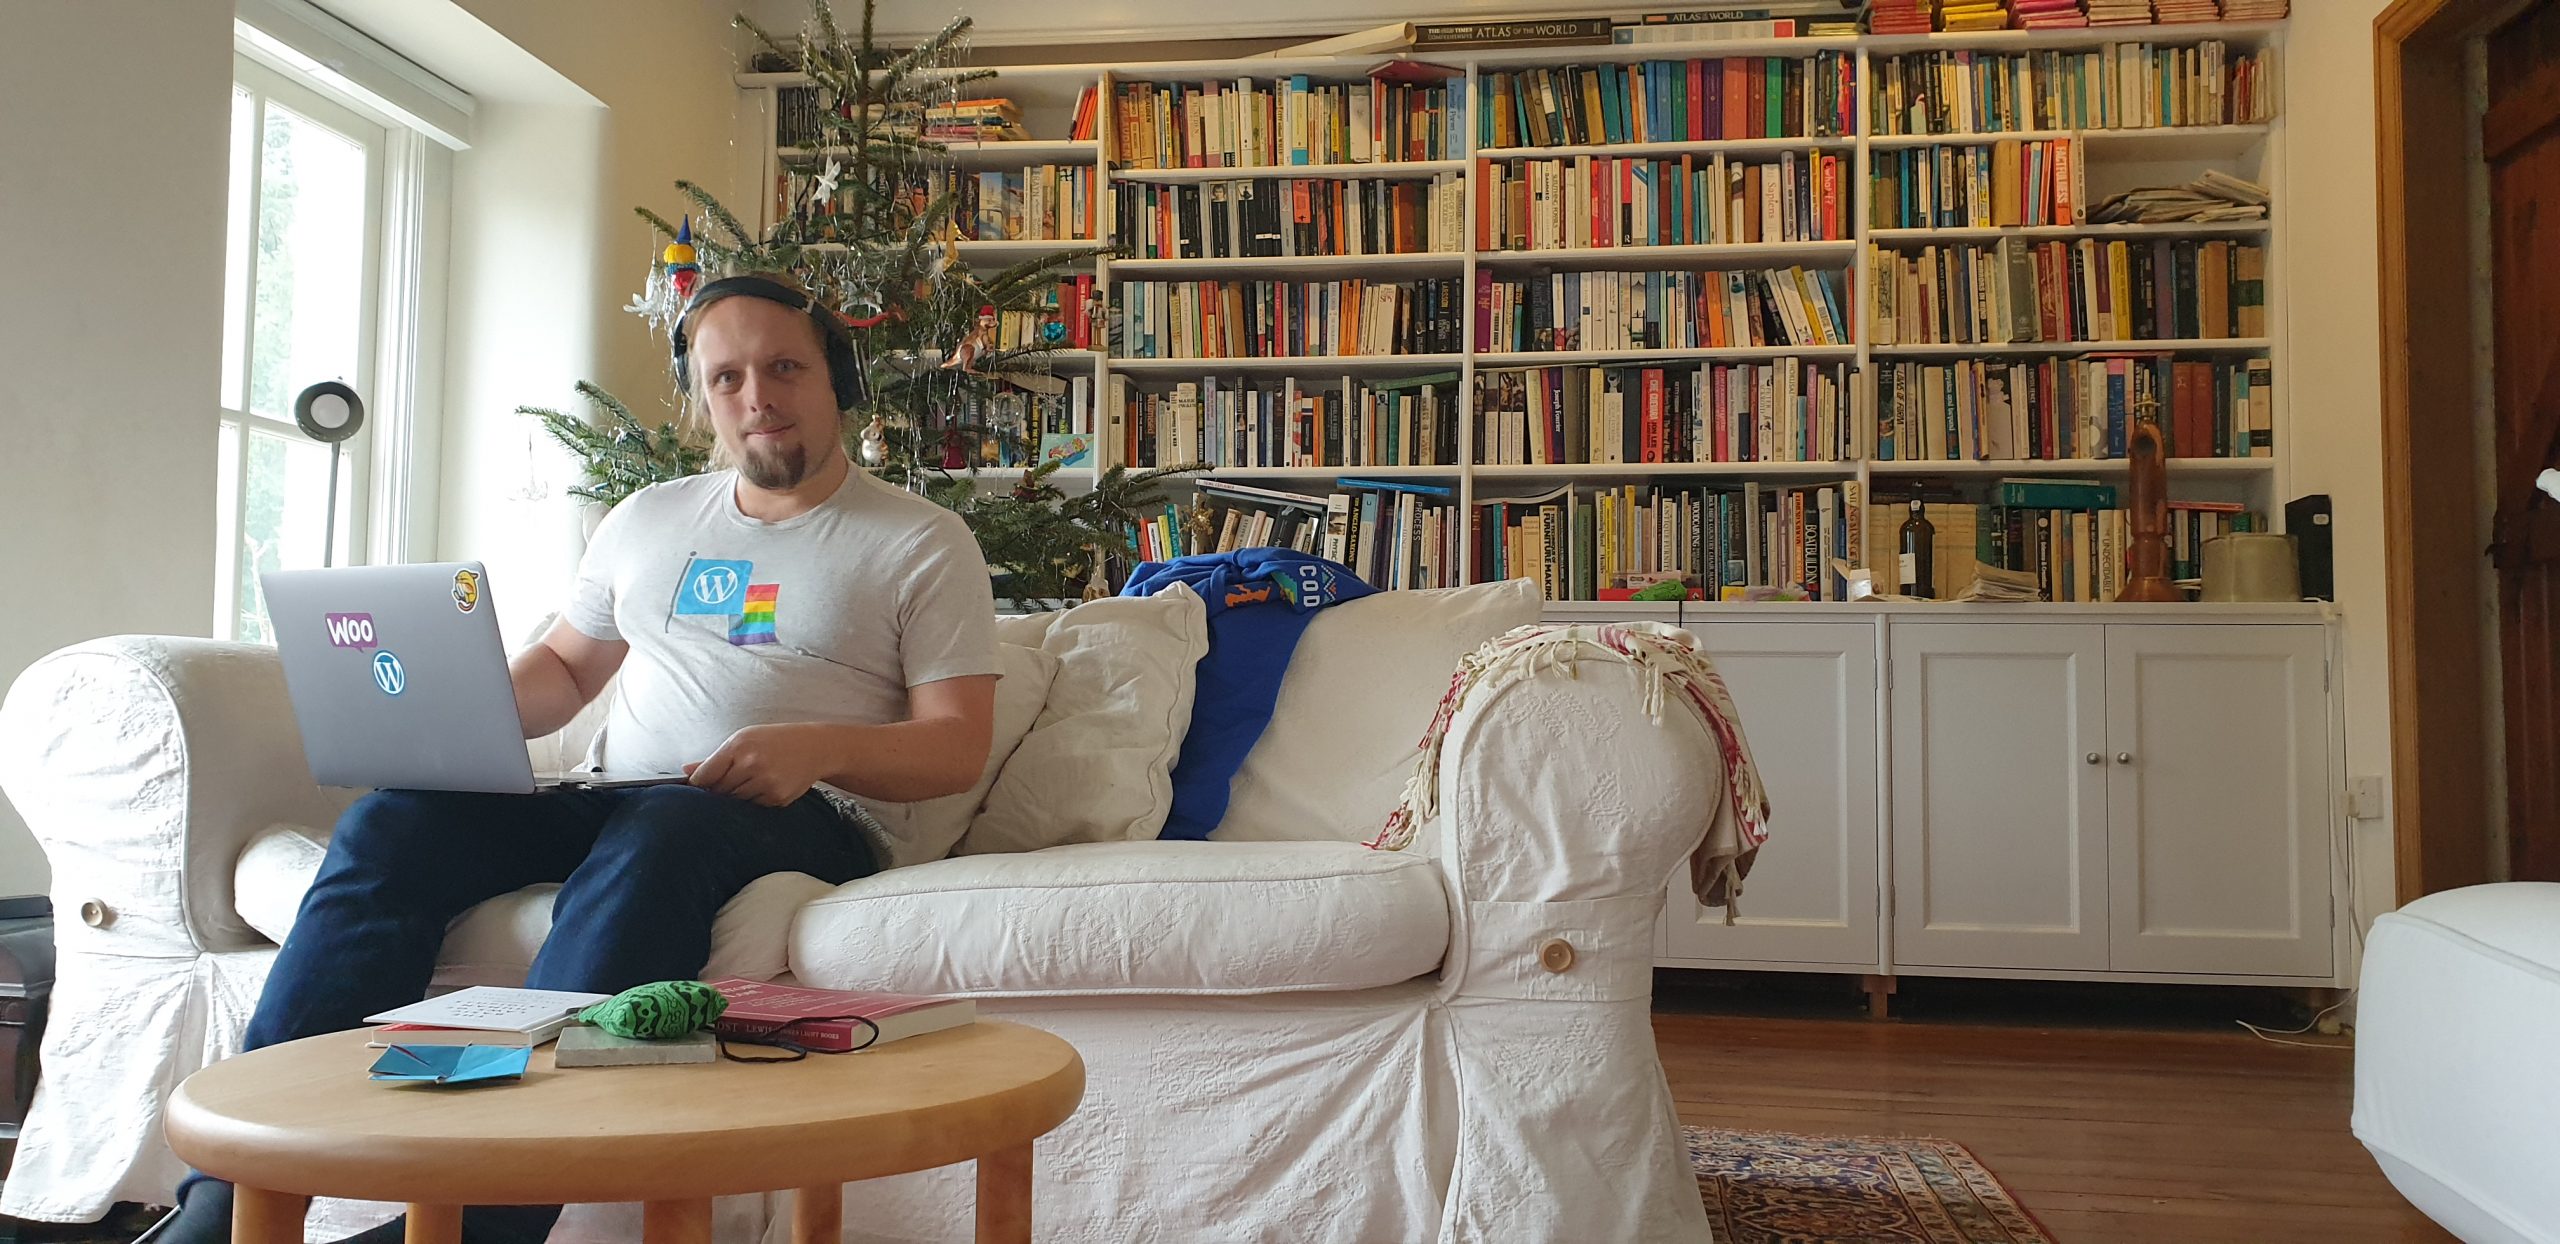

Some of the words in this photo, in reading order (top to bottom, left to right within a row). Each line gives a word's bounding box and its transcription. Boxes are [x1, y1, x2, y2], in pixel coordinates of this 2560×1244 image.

[1673, 12, 1700, 22] ATLAS
[1709, 11, 1744, 21] WORLD
[1476, 26, 1511, 38] ATLAS
[1523, 27, 1534, 35] THE
[1536, 24, 1578, 36] WORLD
[2056, 146, 2067, 204] FACTFULNESS
[1766, 182, 1778, 218] Sapiens
[1441, 281, 1449, 308] LARSSON
[1650, 379, 1658, 392] CHE
[1896, 370, 1905, 391] LAWS
[1945, 368, 1956, 393] physics
[1554, 389, 1562, 410] Joseph
[1650, 393, 1658, 420] GUEVARA
[1896, 401, 1905, 425] FORM
[1554, 410, 1562, 433] Fourier
[1945, 408, 1956, 431] beyond
[1848, 485, 1858, 524] SAILING
[1348, 507, 1360, 562] ANGLO-SAXONS
[1412, 501, 1422, 541] PROCESS
[1692, 501, 1701, 547] WOODCARVING
[1330, 538, 1339, 560] PHYSIC
[1543, 513, 1553, 564] FURNITURE
[1806, 524, 1817, 585] BOATBUILDIN
[2102, 538, 2111, 593] UNDECIDABLE
[1543, 564, 1553, 601] MAKING
[326, 616, 373, 646] WOO
[717, 1021, 738, 1034] OST
[820, 1032, 840, 1040] BOOKS
